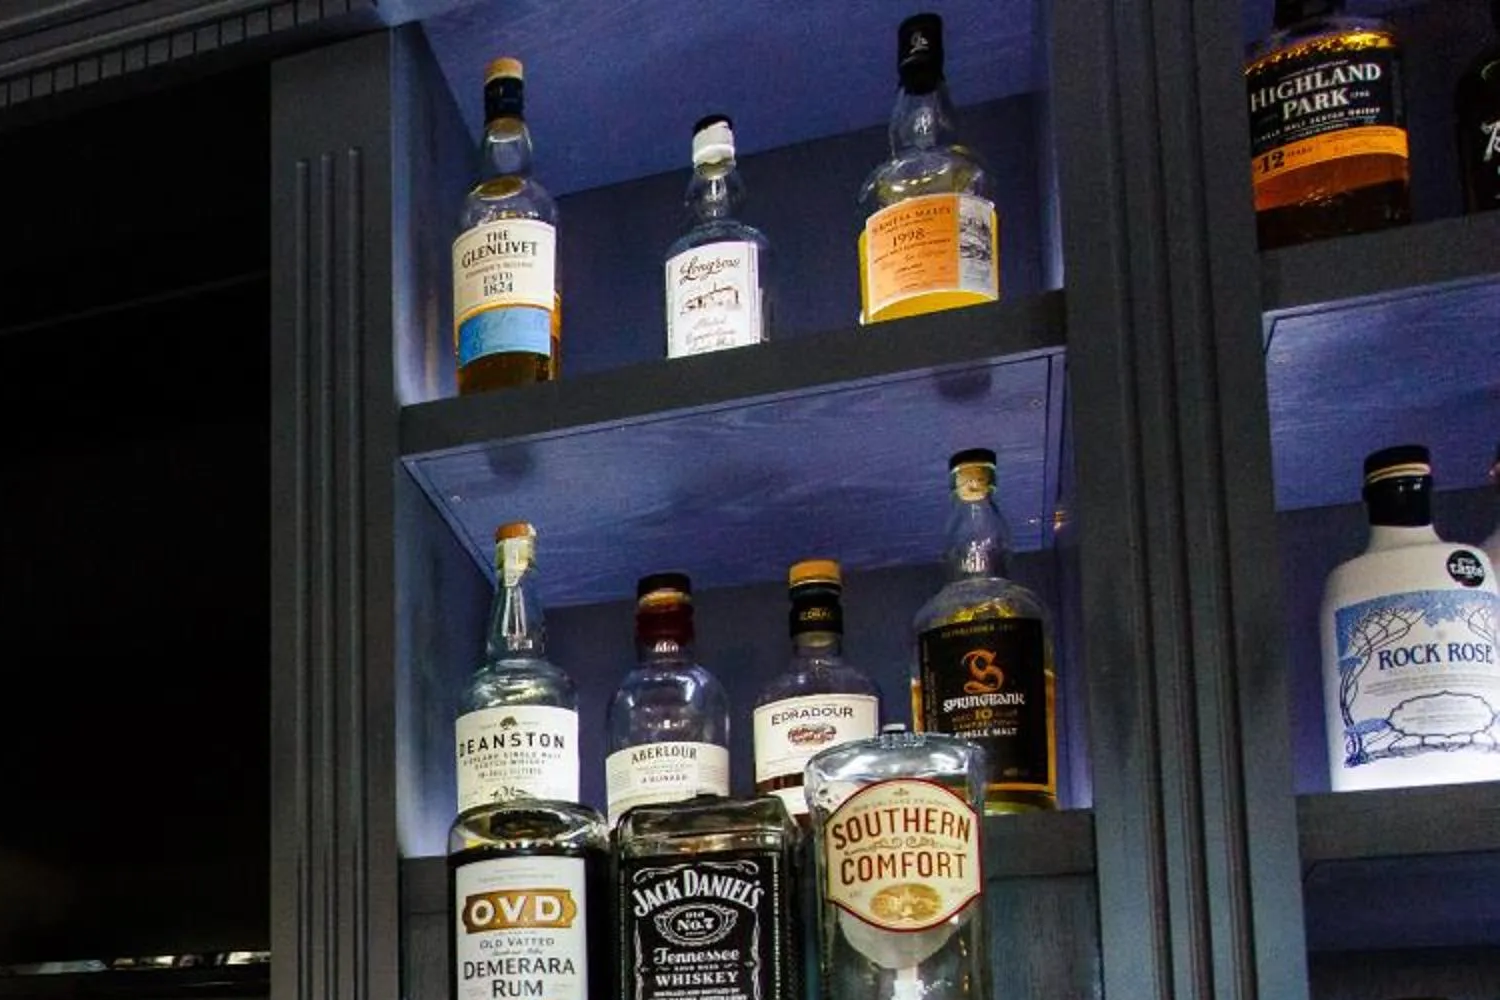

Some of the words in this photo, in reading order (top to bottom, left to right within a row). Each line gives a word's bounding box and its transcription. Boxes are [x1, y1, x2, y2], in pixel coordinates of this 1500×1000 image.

[1251, 62, 1382, 112] HIGHLAND
[1283, 88, 1349, 120] PARK
[1258, 151, 1285, 173] 12
[486, 230, 508, 243] THE
[461, 241, 539, 269] GLENLIVET
[1378, 643, 1442, 671] ROCK
[1447, 642, 1494, 665] ROSE
[771, 706, 854, 726] EDRADOUR
[630, 747, 698, 765] ABERLOUR
[831, 807, 970, 850] SOUTHERN
[840, 851, 966, 886] COMFORT
[632, 877, 683, 917] JACK
[683, 869, 765, 910] DANIEL'S
[652, 947, 741, 965] Tennessee
[463, 957, 576, 981] DEMERARA
[655, 971, 740, 987] WHISKEY
[492, 979, 544, 999] RUM
